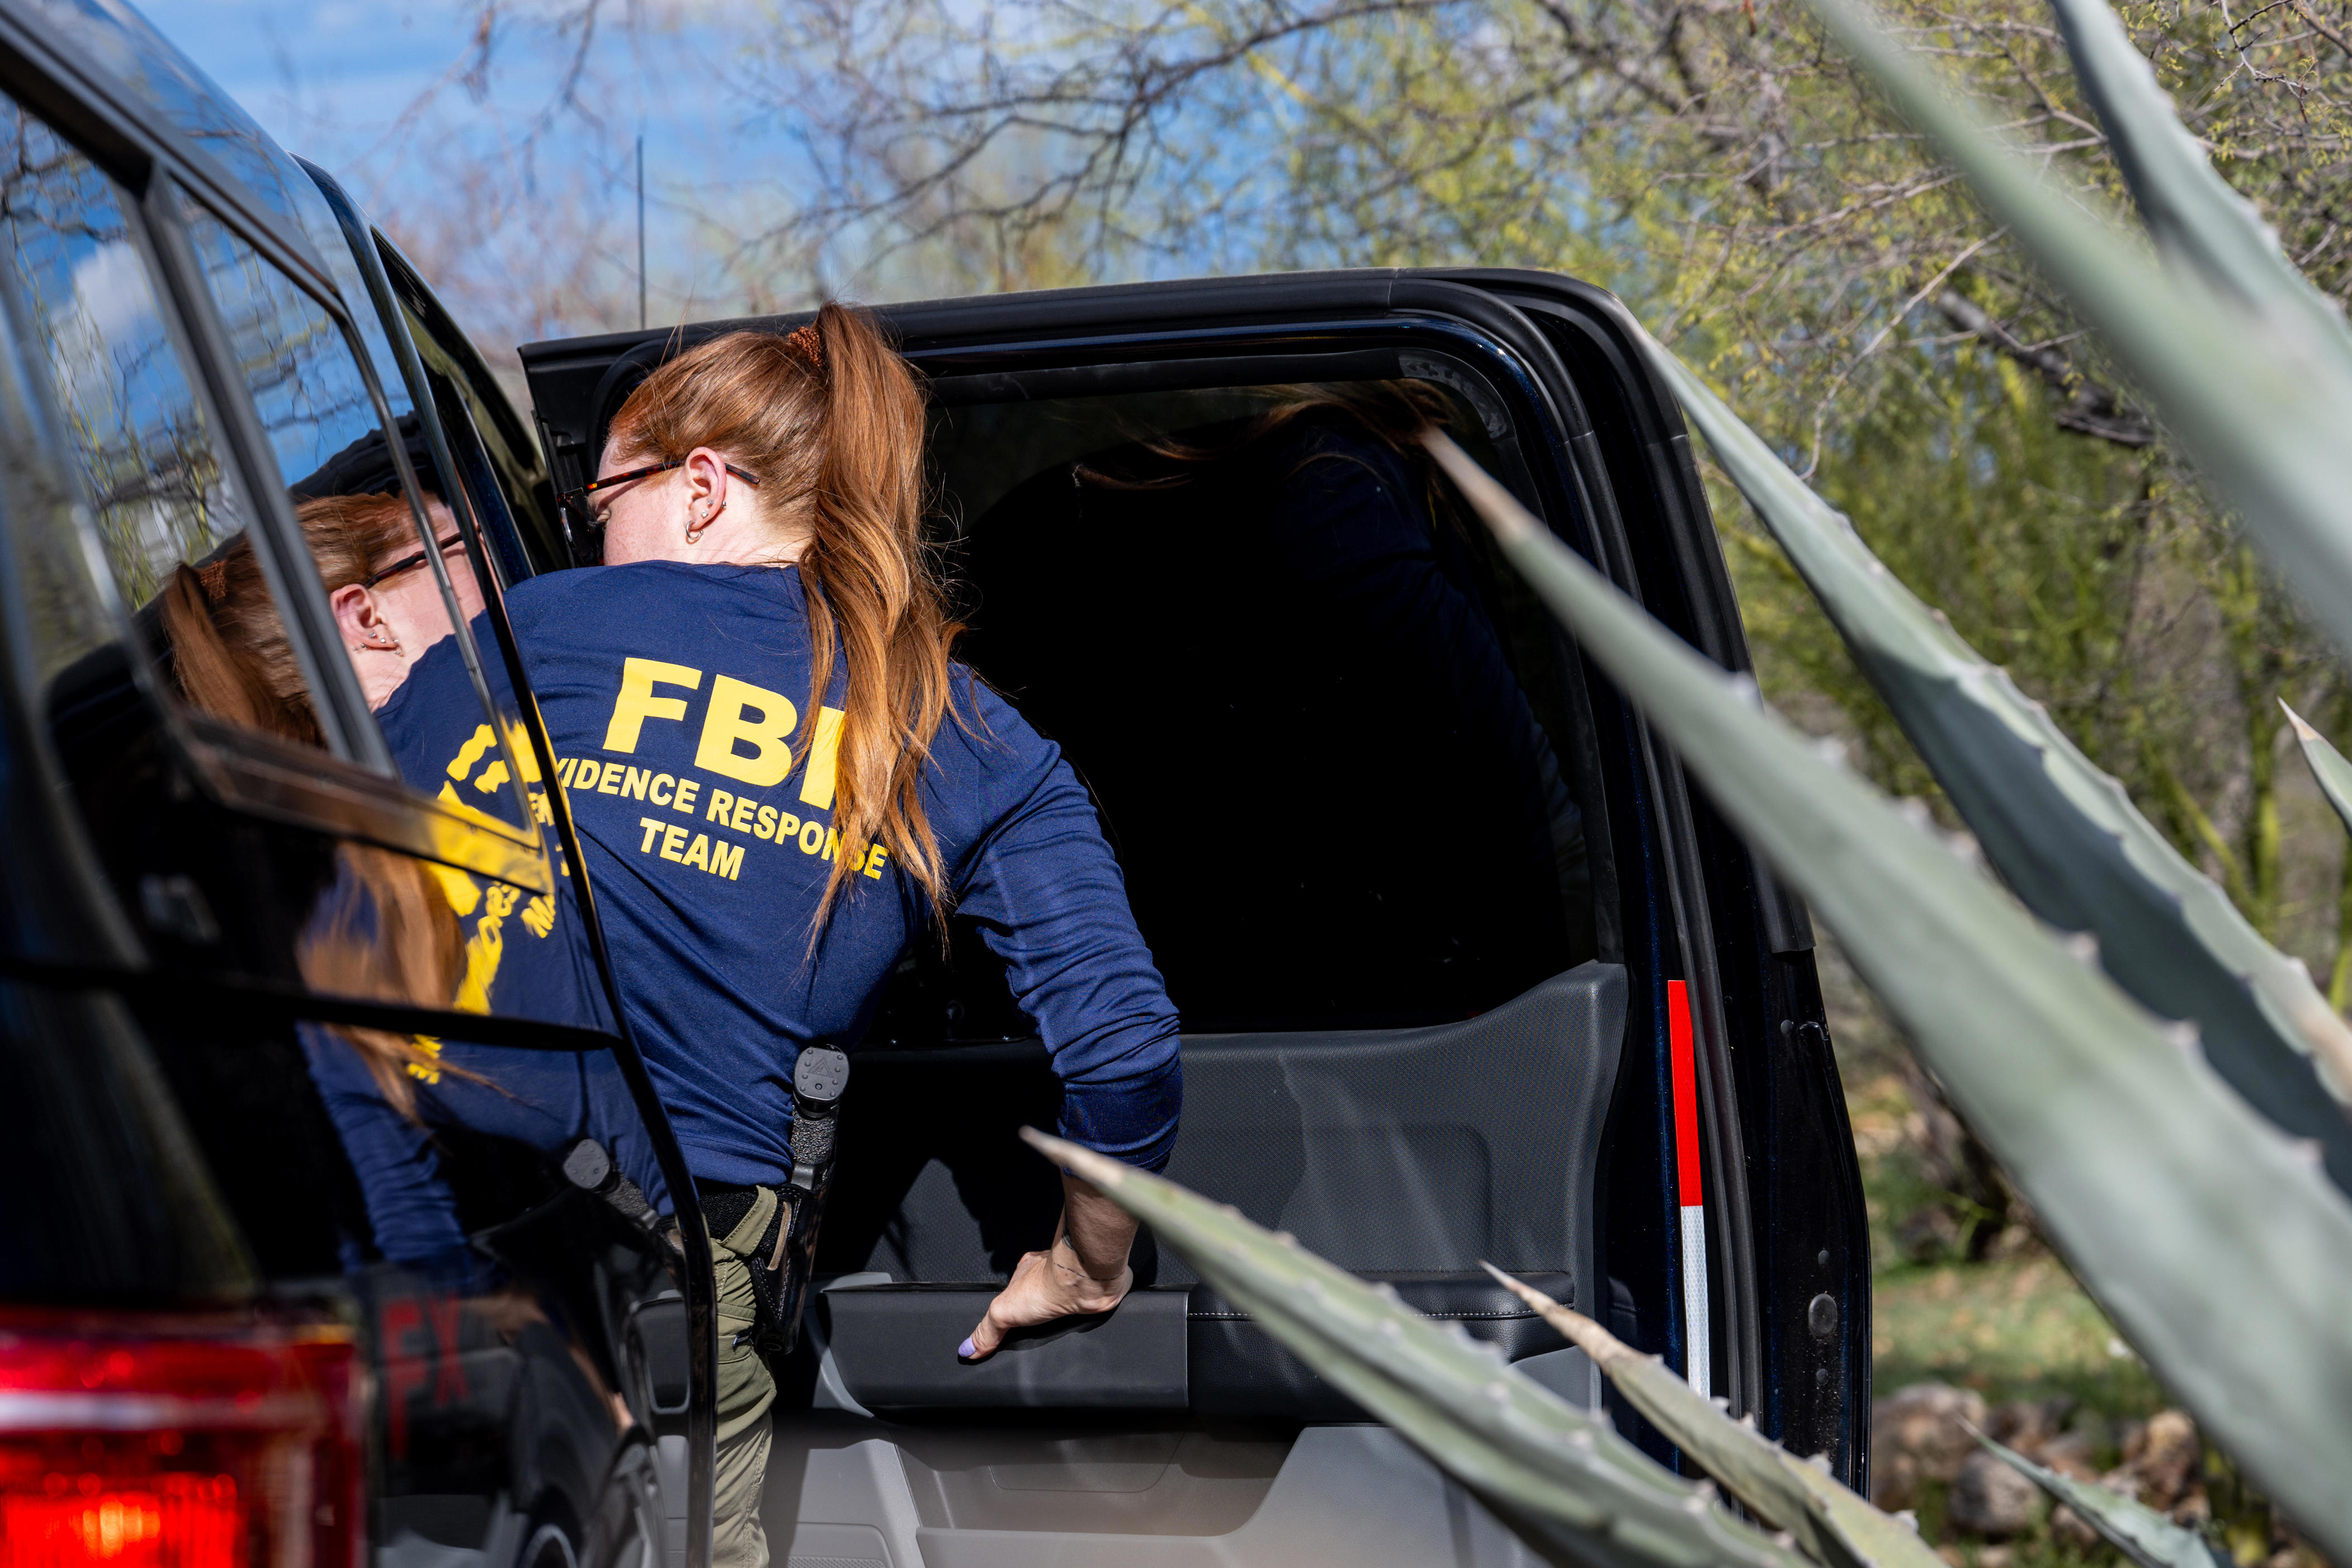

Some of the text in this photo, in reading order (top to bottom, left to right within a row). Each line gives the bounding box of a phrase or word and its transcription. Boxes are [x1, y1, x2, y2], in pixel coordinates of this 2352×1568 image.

[602, 657, 845, 810] FBI
[558, 758, 701, 814] IDENCE
[640, 817, 745, 881] TEAM
